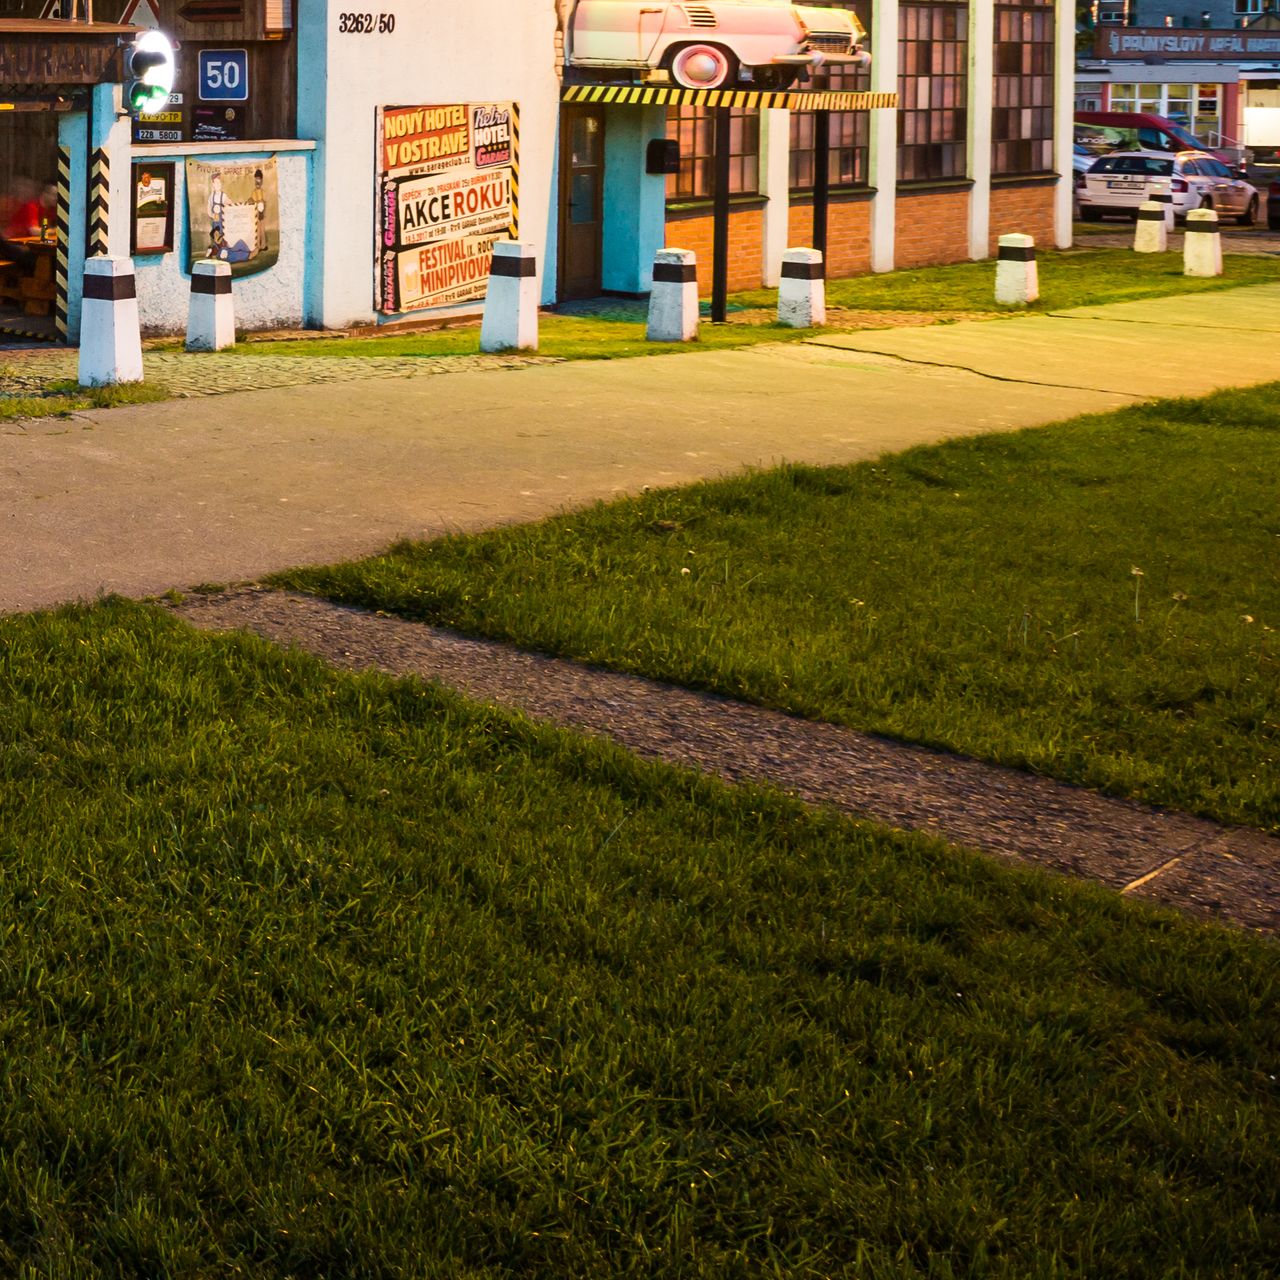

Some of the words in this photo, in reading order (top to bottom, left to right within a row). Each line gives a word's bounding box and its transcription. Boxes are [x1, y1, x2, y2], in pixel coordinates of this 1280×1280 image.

[339, 13, 395, 34] 3262/50
[206, 61, 240, 89] 50
[384, 107, 425, 139] NOVÝ
[426, 105, 467, 132] HOTEL
[473, 106, 510, 129] Retro
[386, 143, 399, 166] V
[400, 127, 469, 164] OSTRAVĚ
[474, 124, 511, 147] HOTEL
[403, 193, 451, 231] AKCE
[453, 179, 511, 217] ROKU!
[418, 238, 467, 273] FESTIVAL
[420, 254, 492, 295] MINIPIVOVA
